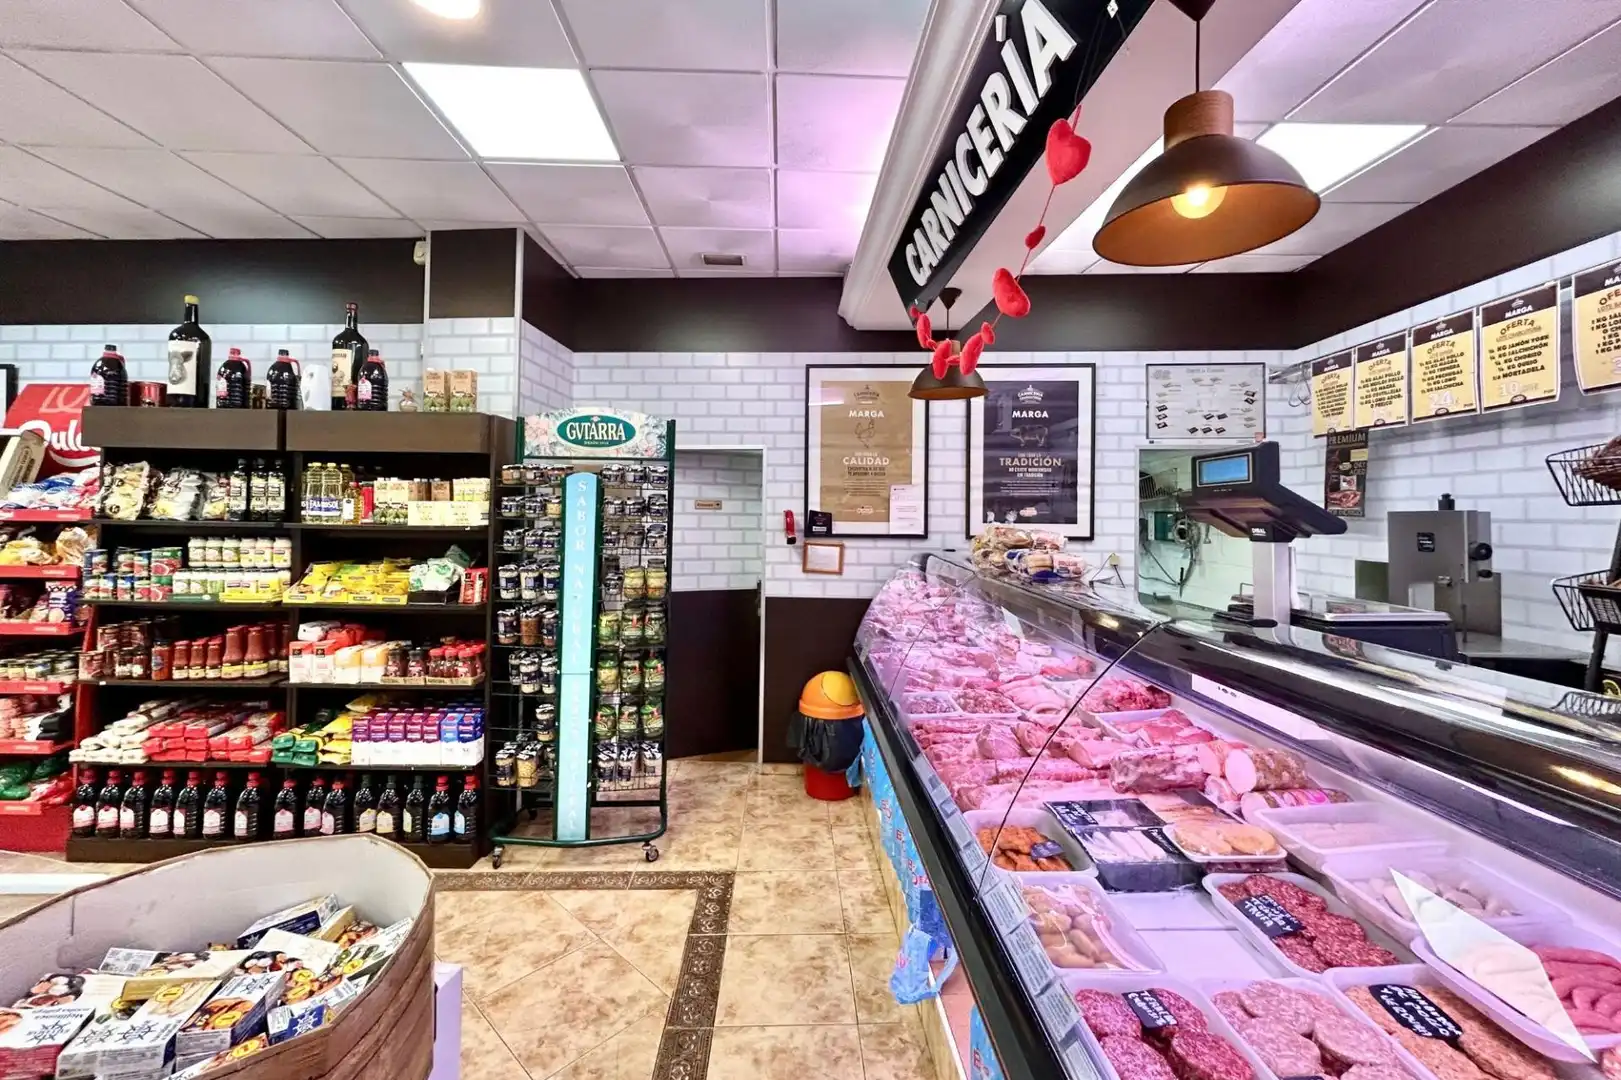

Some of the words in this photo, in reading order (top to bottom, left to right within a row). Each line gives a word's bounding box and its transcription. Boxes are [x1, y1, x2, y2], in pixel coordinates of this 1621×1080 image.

[905, 0, 1077, 287] CARNICERÍA
[1599, 288, 1621, 305] OFE
[1504, 305, 1533, 319] MARGA
[1500, 318, 1535, 335] OFERTA
[1430, 328, 1454, 339] MARGA
[1427, 340, 1456, 354] OFERTA
[1508, 339, 1530, 349] JAMÓN
[1502, 364, 1545, 378] MORTADELA
[848, 410, 885, 418] MARGA
[1011, 410, 1049, 419] MARGA
[1328, 432, 1366, 445] PREMIUM
[842, 457, 890, 465] CALIDAD
[999, 455, 1062, 467] TRADICIÓN
[575, 480, 587, 551] SABOR
